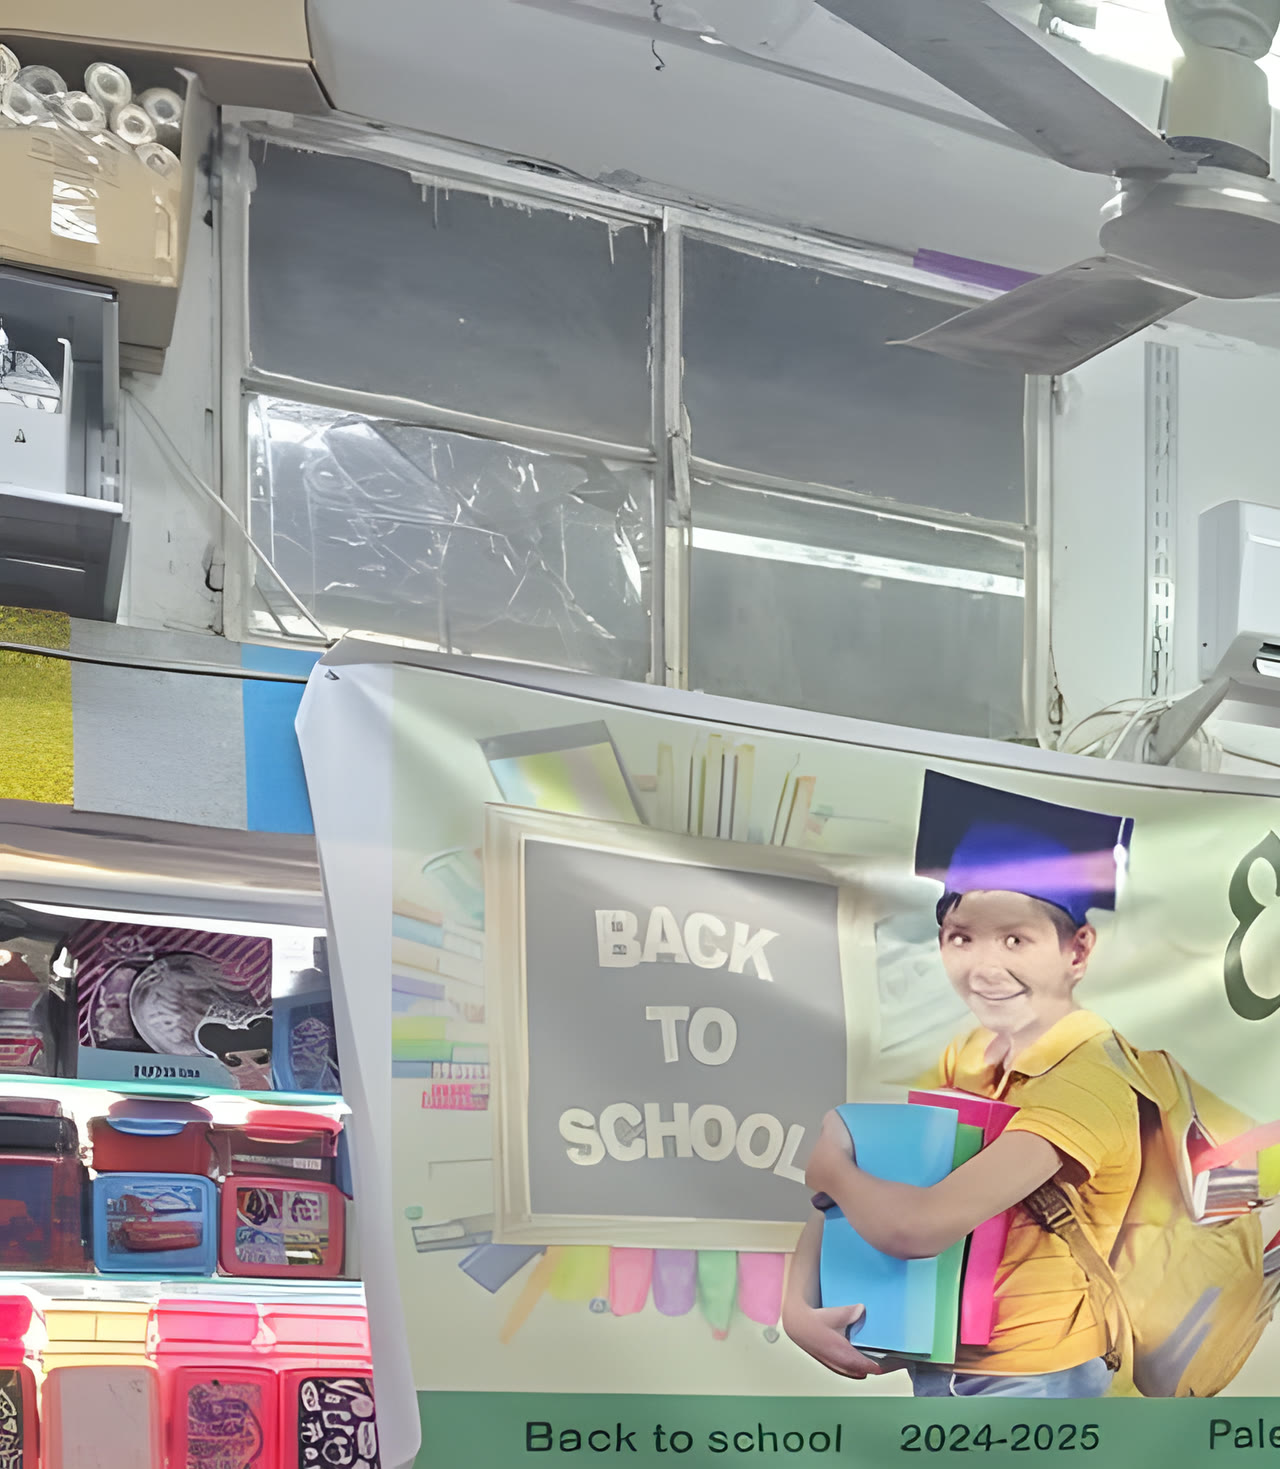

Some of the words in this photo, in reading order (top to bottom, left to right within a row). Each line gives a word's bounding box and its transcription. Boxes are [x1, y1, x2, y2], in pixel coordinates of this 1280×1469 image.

[595, 904, 782, 983] BACK
[645, 1005, 738, 1066] TO
[558, 1102, 806, 1186] SCHOOL
[525, 1421, 637, 1453] Back
[653, 1423, 694, 1453] to
[707, 1423, 843, 1454] school
[900, 1423, 1100, 1453] 2024-2025
